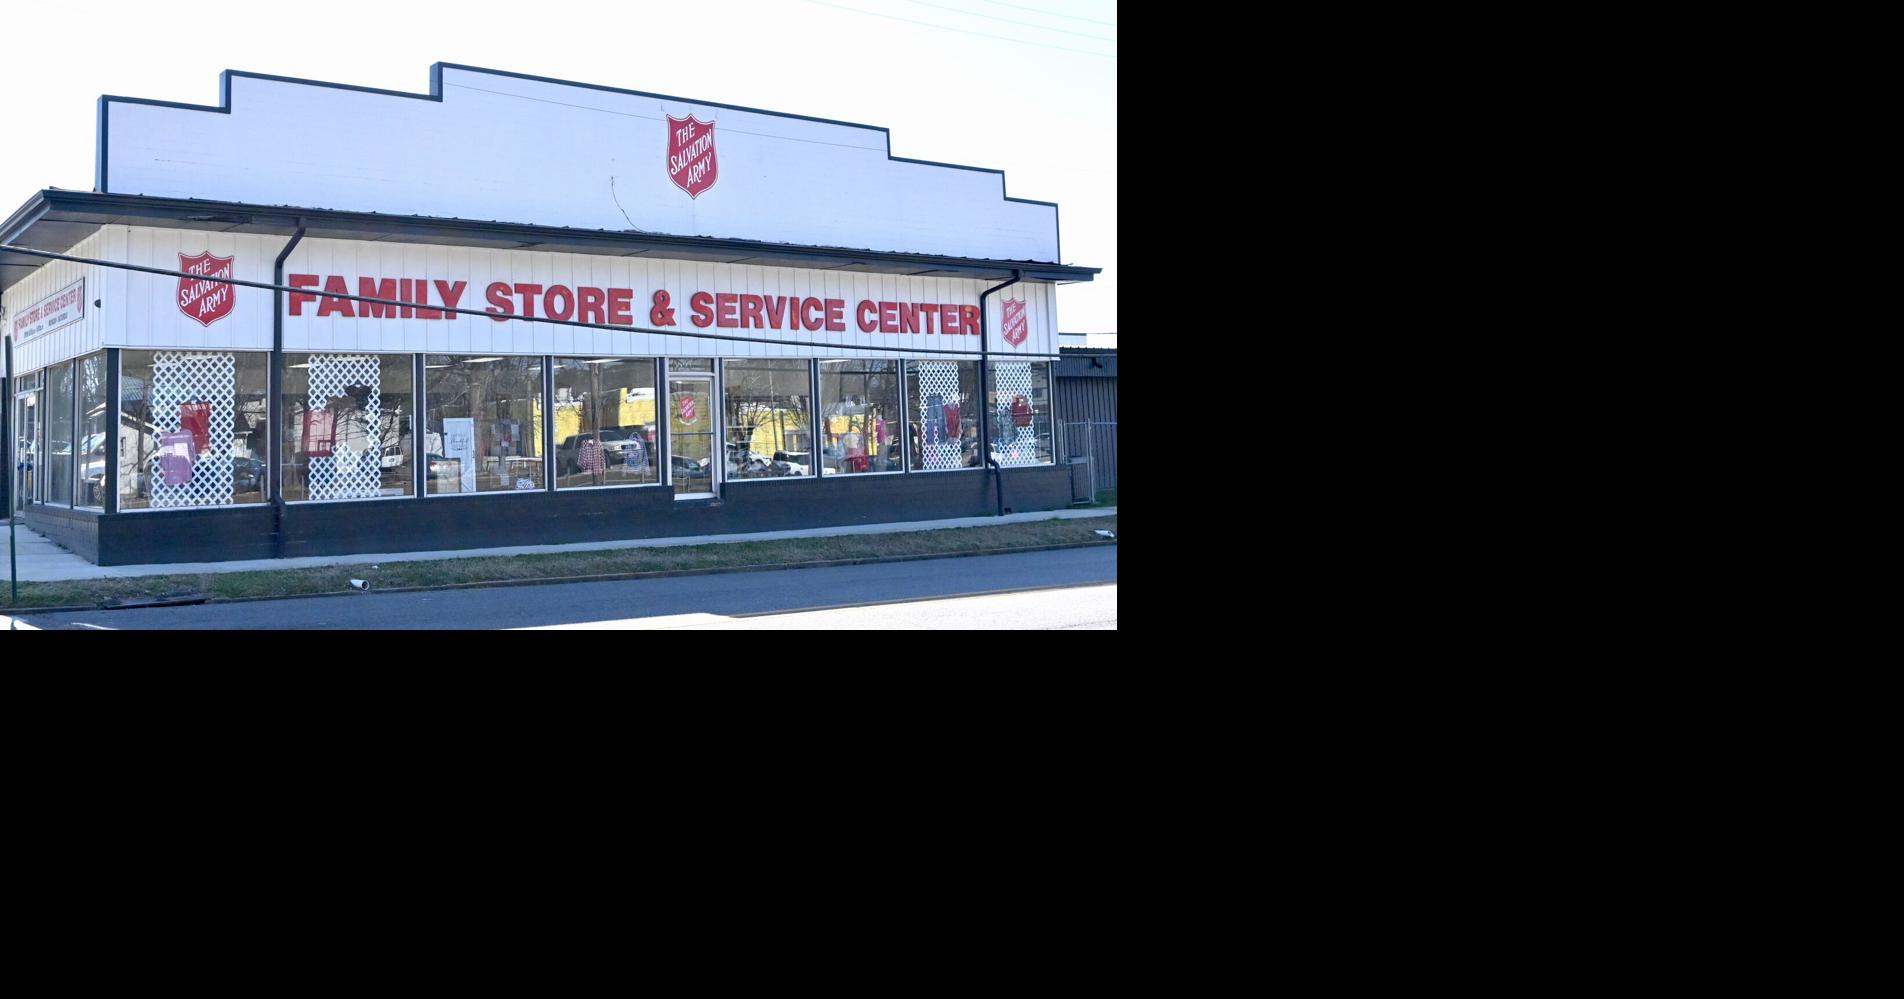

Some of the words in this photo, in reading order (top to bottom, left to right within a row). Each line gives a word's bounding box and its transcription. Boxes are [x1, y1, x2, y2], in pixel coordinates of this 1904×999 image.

[670, 128, 712, 175] SALVATION
[676, 122, 695, 147] THE
[687, 152, 712, 188] ARMY
[181, 262, 229, 307] SALVATION
[188, 258, 210, 282] THE
[199, 284, 228, 317] ARMY
[289, 273, 467, 320] FAMILY
[486, 281, 633, 325] STORE
[650, 289, 676, 326] &
[690, 291, 846, 332] SERVICE
[856, 299, 980, 336] CENTER
